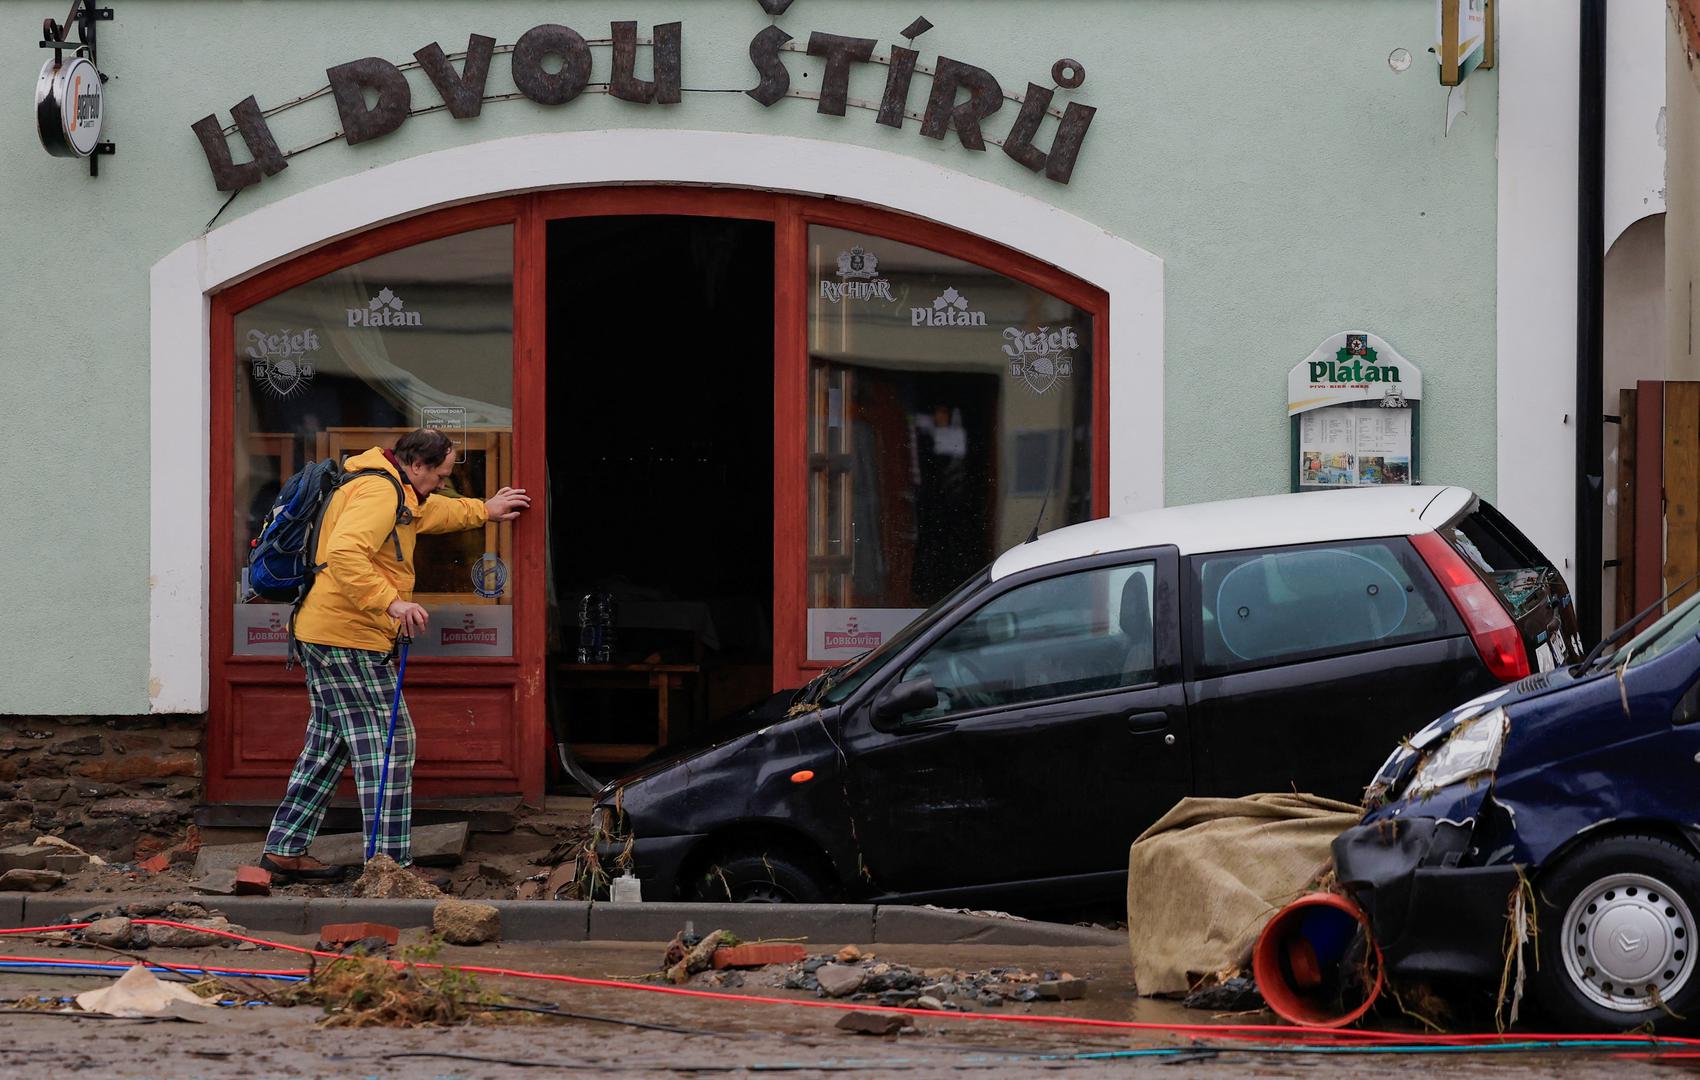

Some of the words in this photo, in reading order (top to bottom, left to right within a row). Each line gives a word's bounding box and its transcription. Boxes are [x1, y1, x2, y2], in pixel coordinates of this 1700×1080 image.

[191, 95, 288, 191] U
[326, 20, 682, 146] DVOU
[745, 0, 1097, 185] ŠTÍRŮ
[820, 279, 897, 303] RYCHTÁŘ
[345, 307, 423, 328] Platan
[910, 305, 988, 327] Platan
[245, 328, 320, 358] Ježek
[1001, 326, 1079, 356] Ježek
[1308, 359, 1401, 382] Platan
